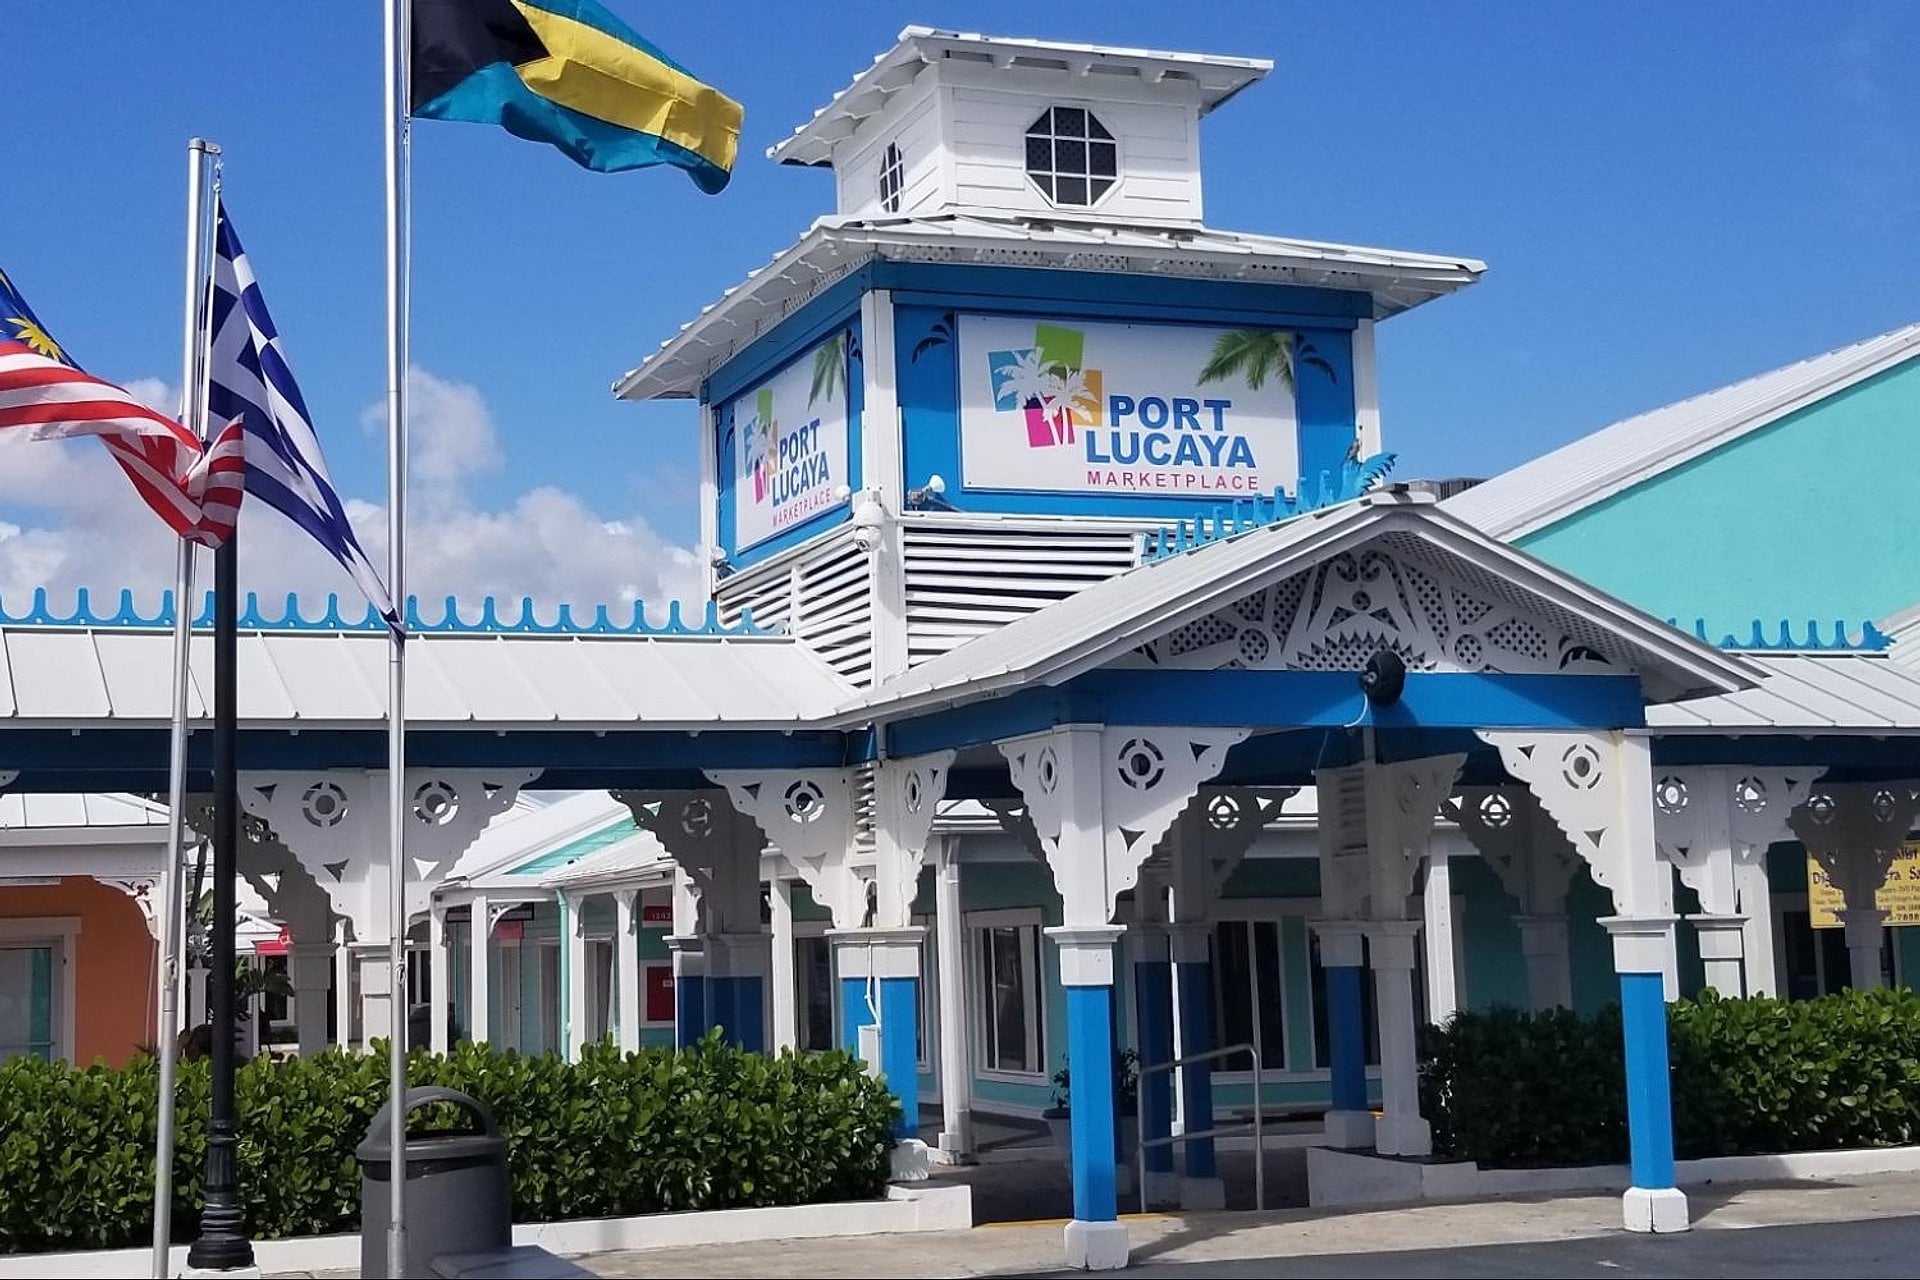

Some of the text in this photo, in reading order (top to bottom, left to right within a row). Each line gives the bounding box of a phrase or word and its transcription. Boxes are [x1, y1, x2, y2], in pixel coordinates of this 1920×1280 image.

[1109, 395, 1232, 431] PORT
[779, 418, 821, 470] PORT
[1085, 430, 1256, 469] LUCAYA
[772, 450, 830, 508] LUCAYA
[1087, 470, 1259, 491] MARKETPLACE
[773, 488, 831, 526] MARKETPLACE
